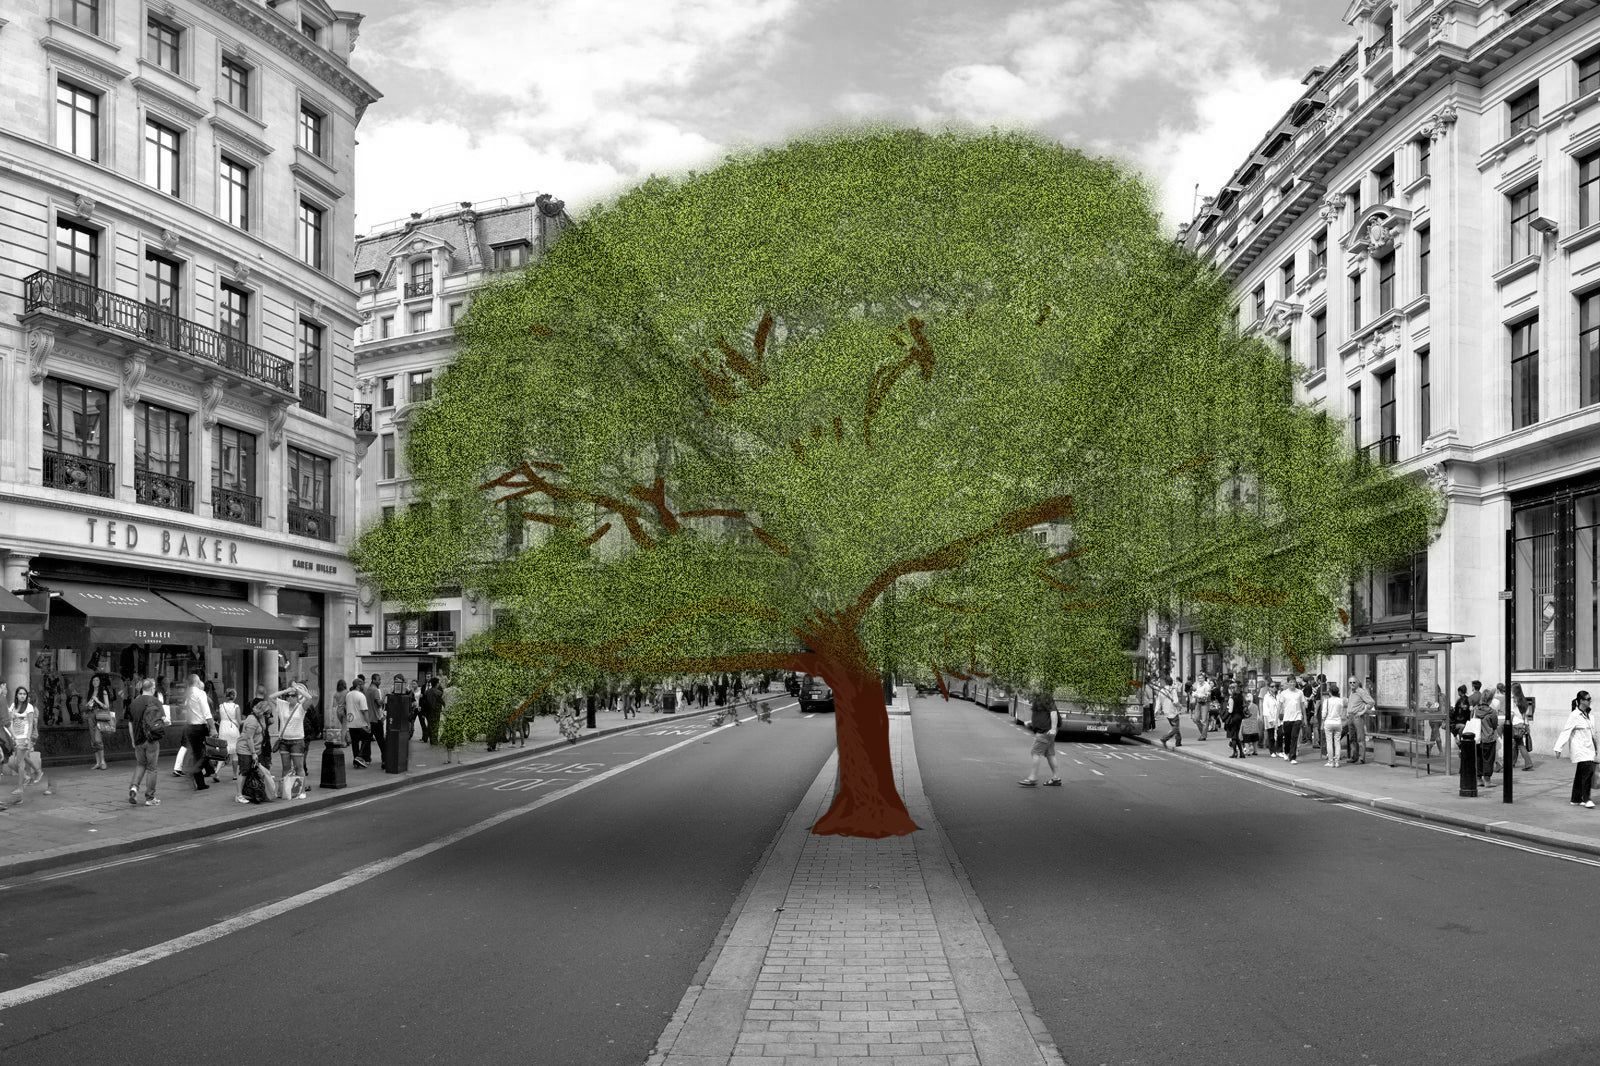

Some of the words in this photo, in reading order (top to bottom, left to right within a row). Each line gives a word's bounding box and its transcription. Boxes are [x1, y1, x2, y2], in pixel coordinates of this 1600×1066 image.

[88, 518, 138, 548] TED
[162, 530, 238, 564] BAKER
[293, 560, 313, 571] KAREN
[316, 563, 337, 574] MILLEN
[135, 630, 147, 638] TED
[151, 631, 171, 639] BAKER
